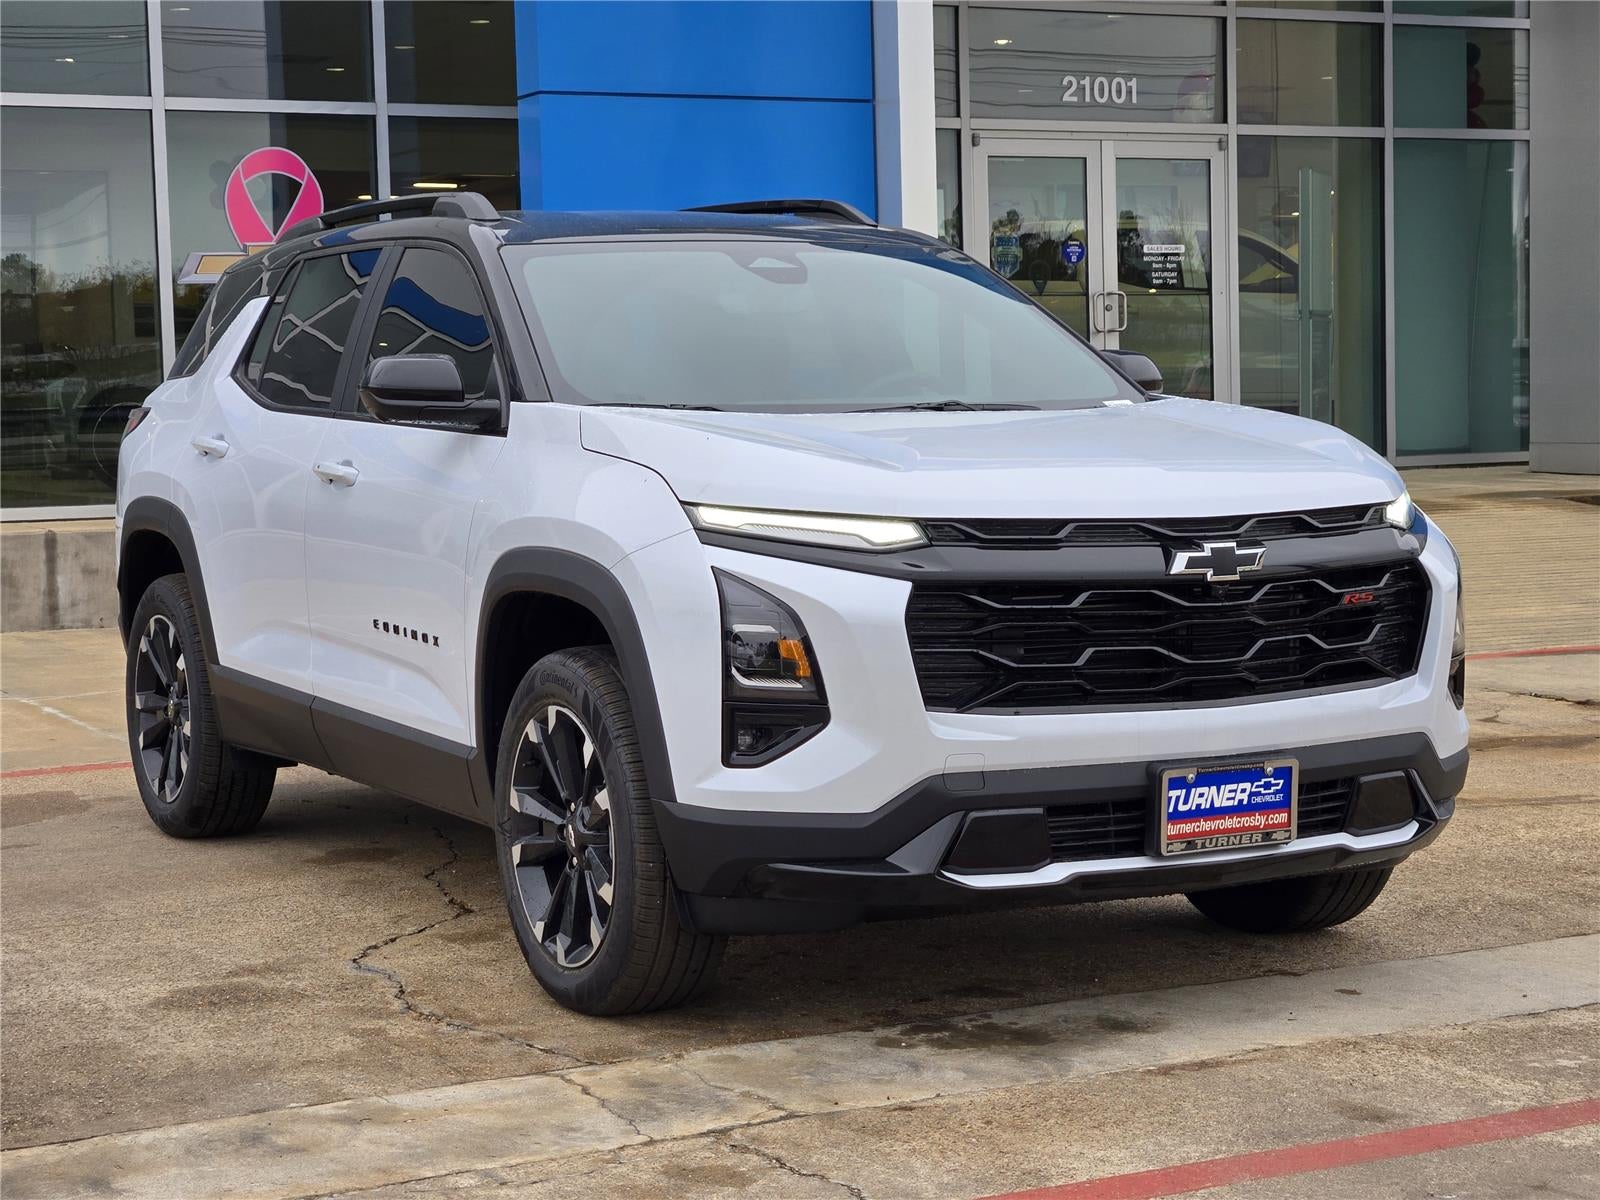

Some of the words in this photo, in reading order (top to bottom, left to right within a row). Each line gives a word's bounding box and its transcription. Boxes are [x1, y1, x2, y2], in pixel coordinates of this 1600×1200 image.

[1062, 75, 1137, 104] 21001
[1343, 591, 1375, 605] RS
[372, 618, 440, 648] EQUINOX
[539, 669, 575, 694] Continental
[1167, 782, 1252, 813] TURNER
[1251, 793, 1284, 804] CHEVROLET
[1167, 812, 1288, 836] turnerchevroletcrosby.com
[1195, 833, 1263, 849] TURNER
